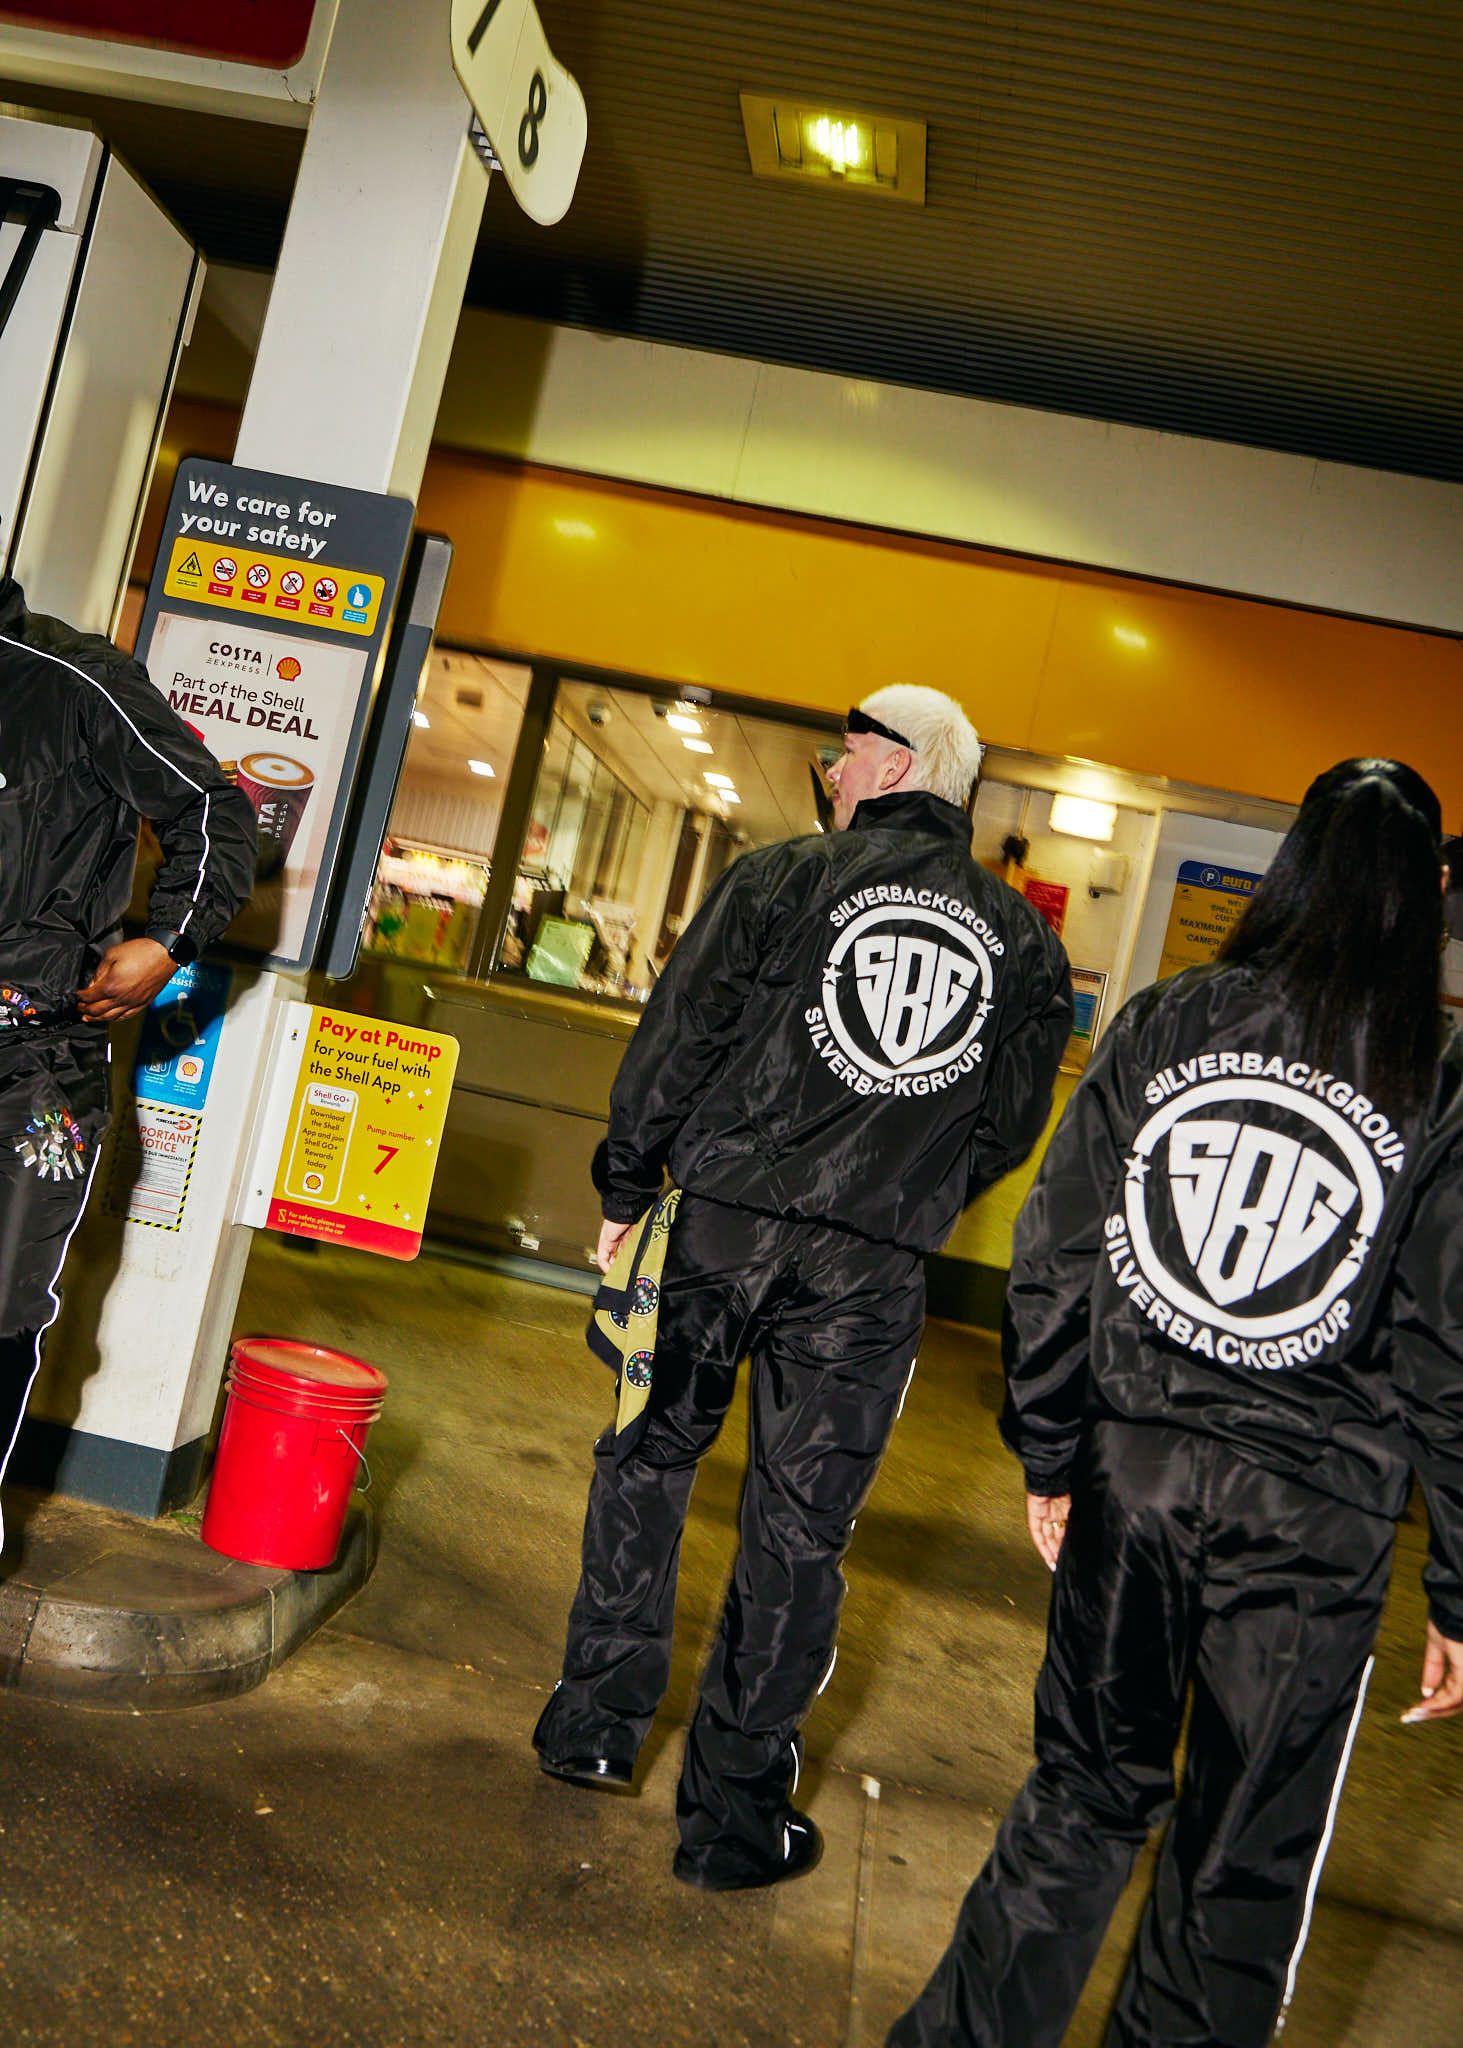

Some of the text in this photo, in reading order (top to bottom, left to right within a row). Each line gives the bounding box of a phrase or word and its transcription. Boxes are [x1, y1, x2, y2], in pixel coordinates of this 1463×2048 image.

[518, 72, 547, 168] 8
[188, 480, 337, 528] We care for
[178, 512, 327, 560] your safety
[209, 642, 262, 664] COSTA
[213, 659, 261, 675] EXPRESS
[172, 672, 305, 713] Part of the Shell
[168, 689, 320, 741] MEAL DEAL
[257, 803, 278, 834] STA
[1221, 875, 1252, 890] euro
[829, 885, 1005, 957] SILVERBACKGROUP
[1179, 917, 1226, 934] MAXIMUM
[854, 935, 979, 1066] SBG
[319, 1016, 442, 1062] Pay at Pump
[314, 1039, 431, 1079] for your fuel with
[309, 1060, 401, 1095] the Shell App
[313, 1089, 332, 1100] Shell
[310, 1108, 345, 1122] Download
[311, 1119, 340, 1131] the Shell
[1145, 1052, 1405, 1174] SILVERBACKGROUP
[137, 1125, 193, 1145] PORTANT
[302, 1127, 345, 1143] App and join
[304, 1138, 338, 1151] Shell GO+
[366, 1124, 416, 1143] Pump number
[304, 1147, 334, 1161] Rewards
[307, 1159, 328, 1170] today
[373, 1144, 400, 1175] 7
[300, 1221, 318, 1229] phone
[1168, 1120, 1359, 1307] SBG
[1104, 1214, 1351, 1371] SILVERBACKGROUP
